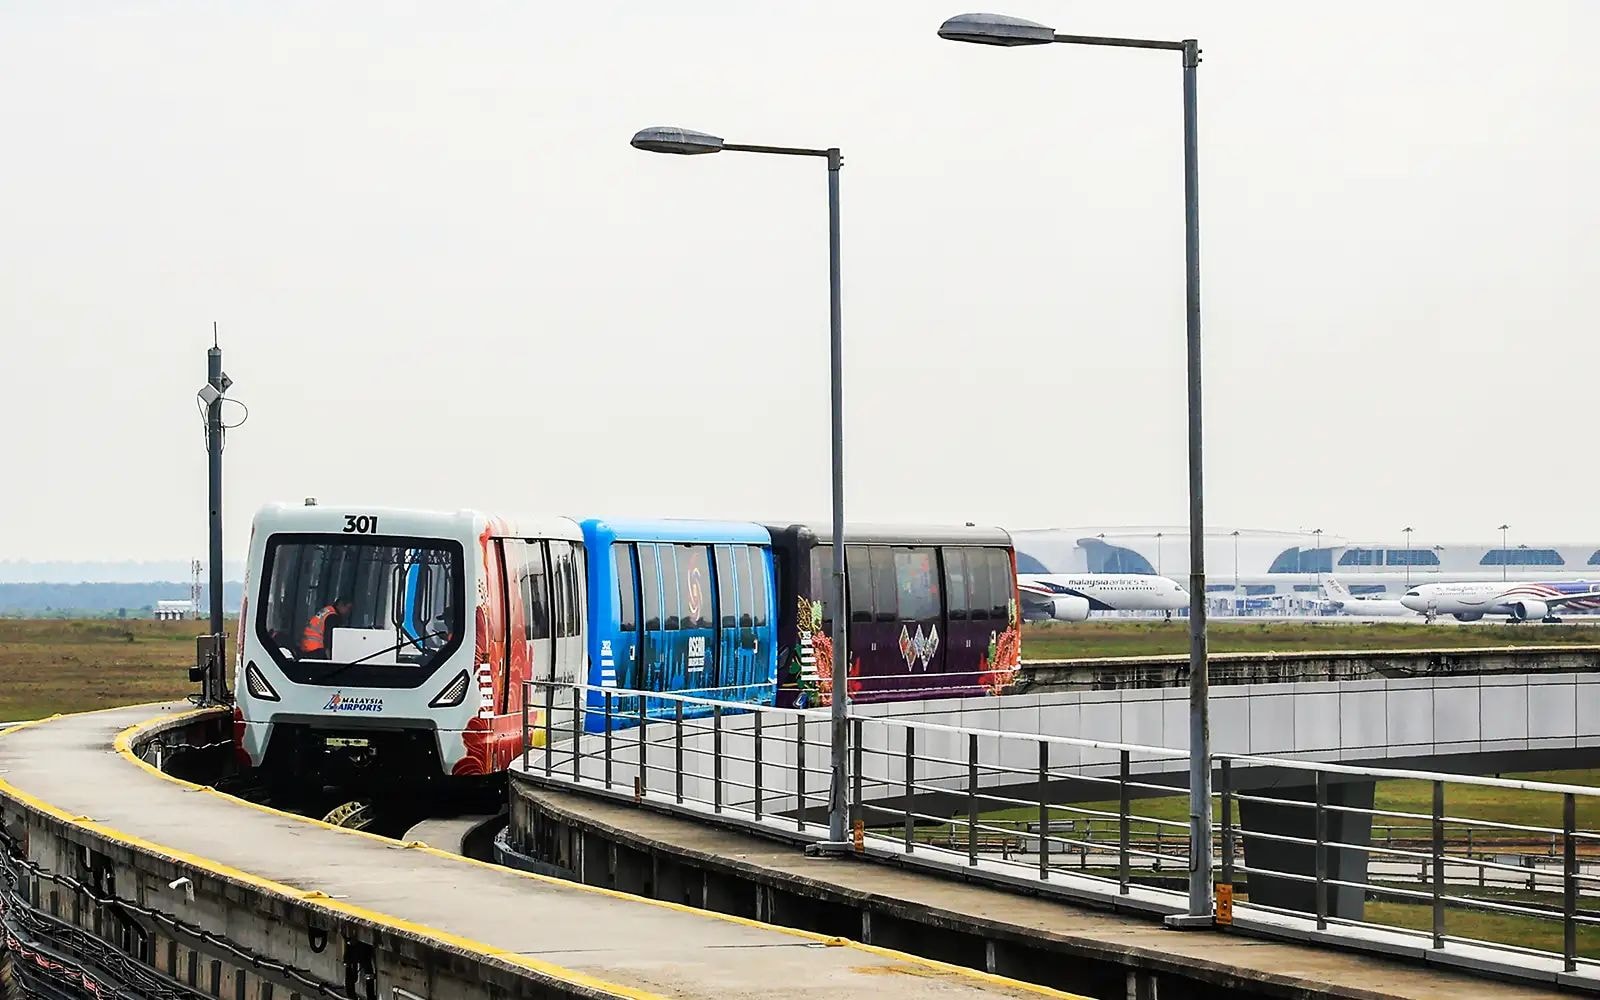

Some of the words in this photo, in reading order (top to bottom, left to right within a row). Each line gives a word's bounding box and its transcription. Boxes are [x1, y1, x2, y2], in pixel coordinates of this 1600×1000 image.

[342, 515, 378, 534] 301
[342, 697, 383, 705] MALAYSIA
[338, 703, 383, 712] AIRPORTS
